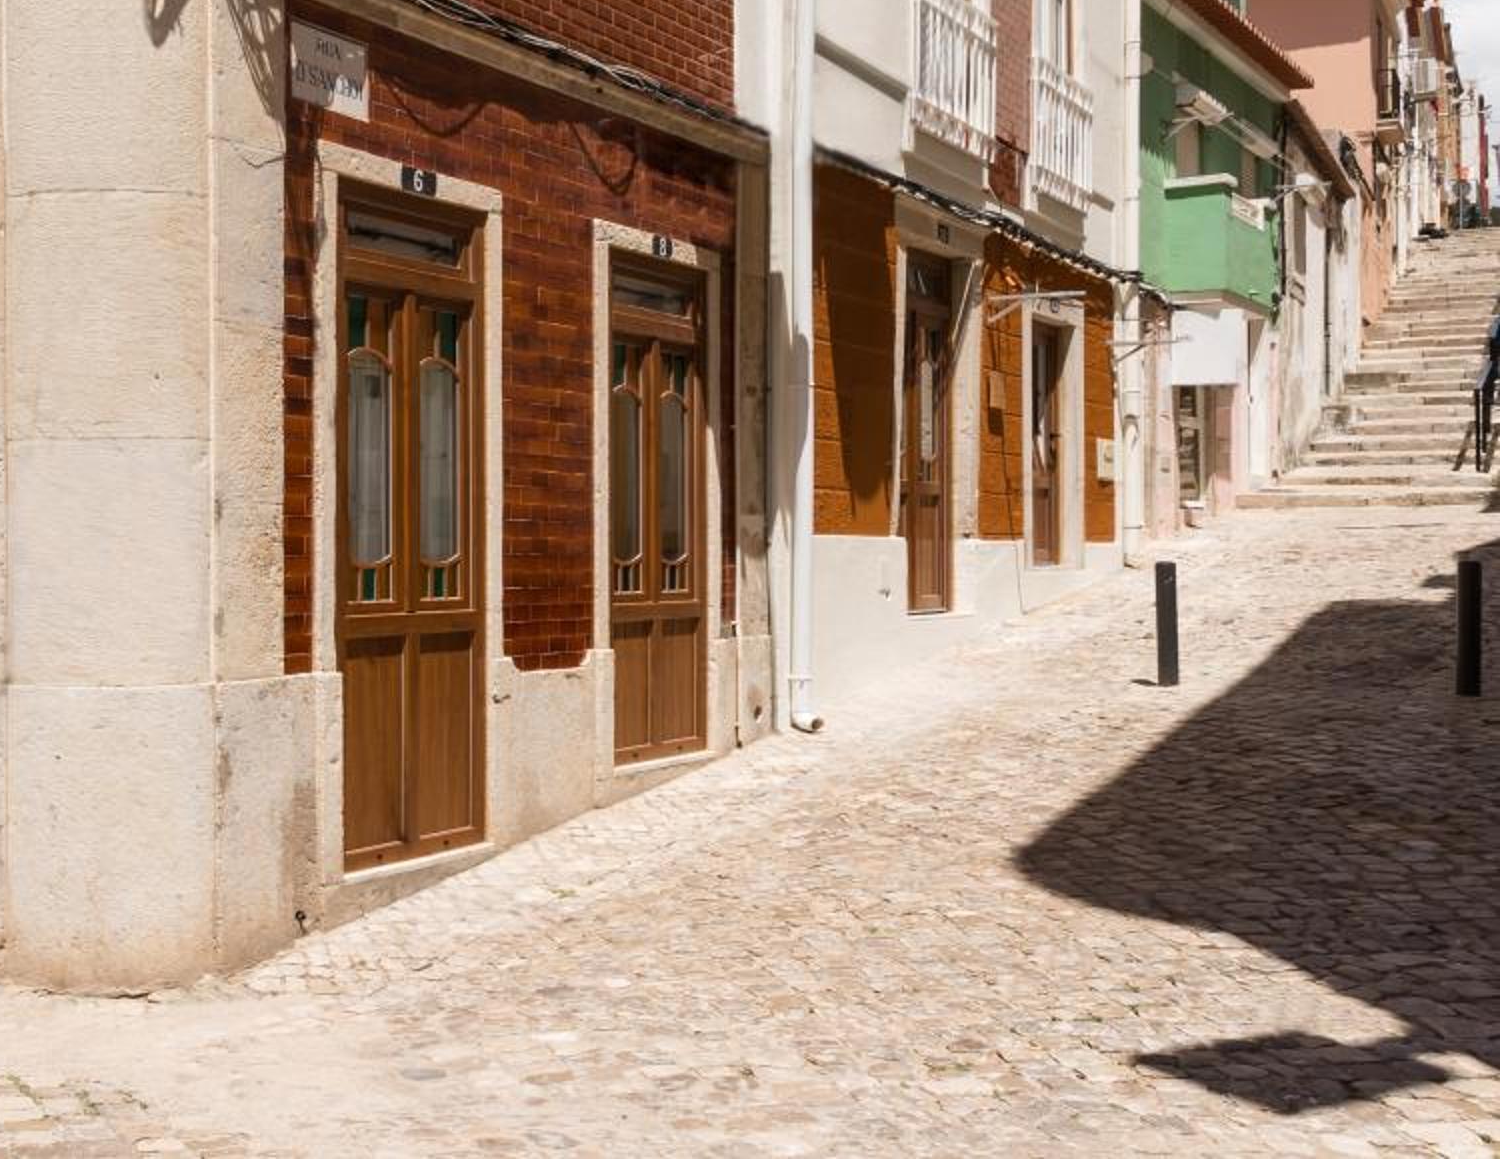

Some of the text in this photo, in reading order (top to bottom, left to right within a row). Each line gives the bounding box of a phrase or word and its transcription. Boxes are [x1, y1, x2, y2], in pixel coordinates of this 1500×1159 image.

[315, 37, 342, 60] RUA
[413, 169, 423, 192] 6
[659, 237, 667, 256] 8
